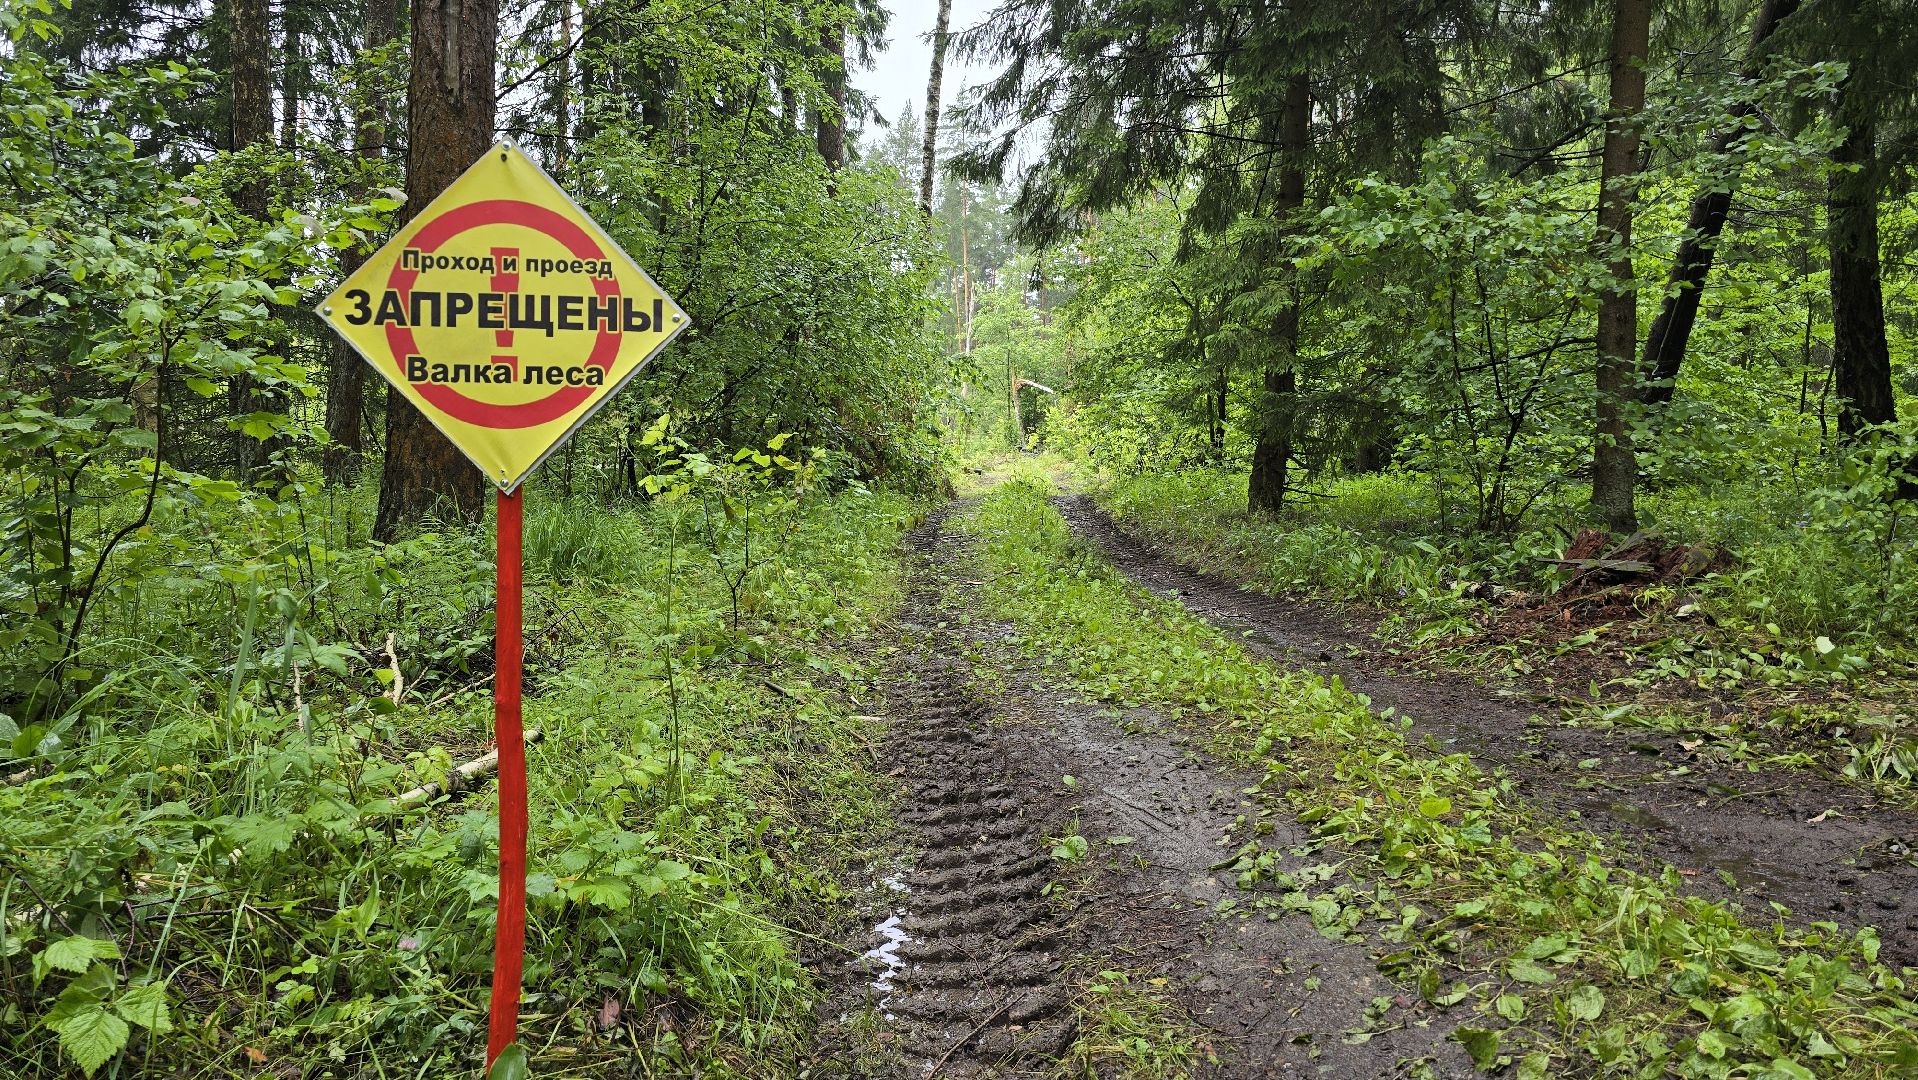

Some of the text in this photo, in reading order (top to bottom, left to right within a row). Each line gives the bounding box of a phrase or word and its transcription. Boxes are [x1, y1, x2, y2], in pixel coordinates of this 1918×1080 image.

[403, 250, 612, 278] Проход и проезд
[344, 289, 663, 337] ЗАПРЕЩЕНЫ
[408, 357, 604, 386] Валка леса
